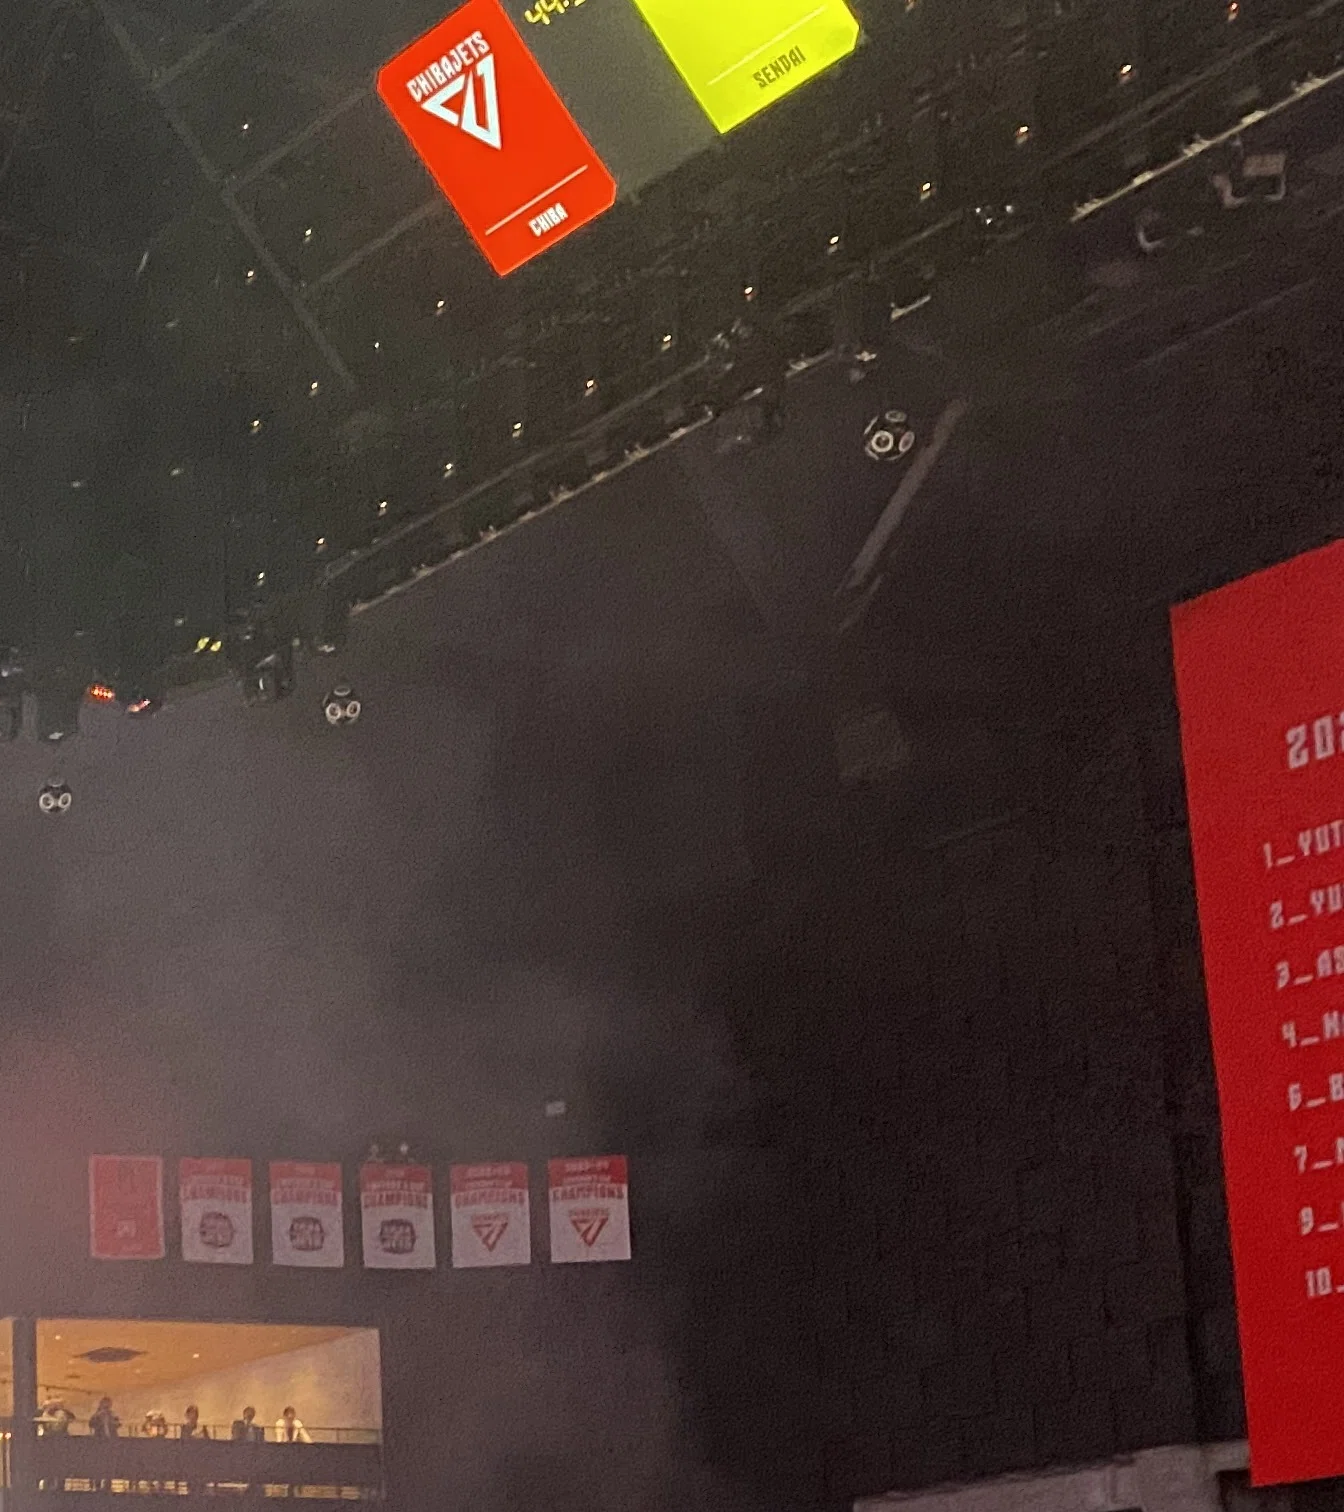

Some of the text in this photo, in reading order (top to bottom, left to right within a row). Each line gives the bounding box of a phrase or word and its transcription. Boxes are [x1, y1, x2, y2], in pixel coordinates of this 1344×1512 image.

[406, 30, 491, 103] CHIBAJETS
[752, 45, 807, 90] SENDAI
[528, 202, 569, 238] CHIBA
[1286, 709, 1344, 769] 20
